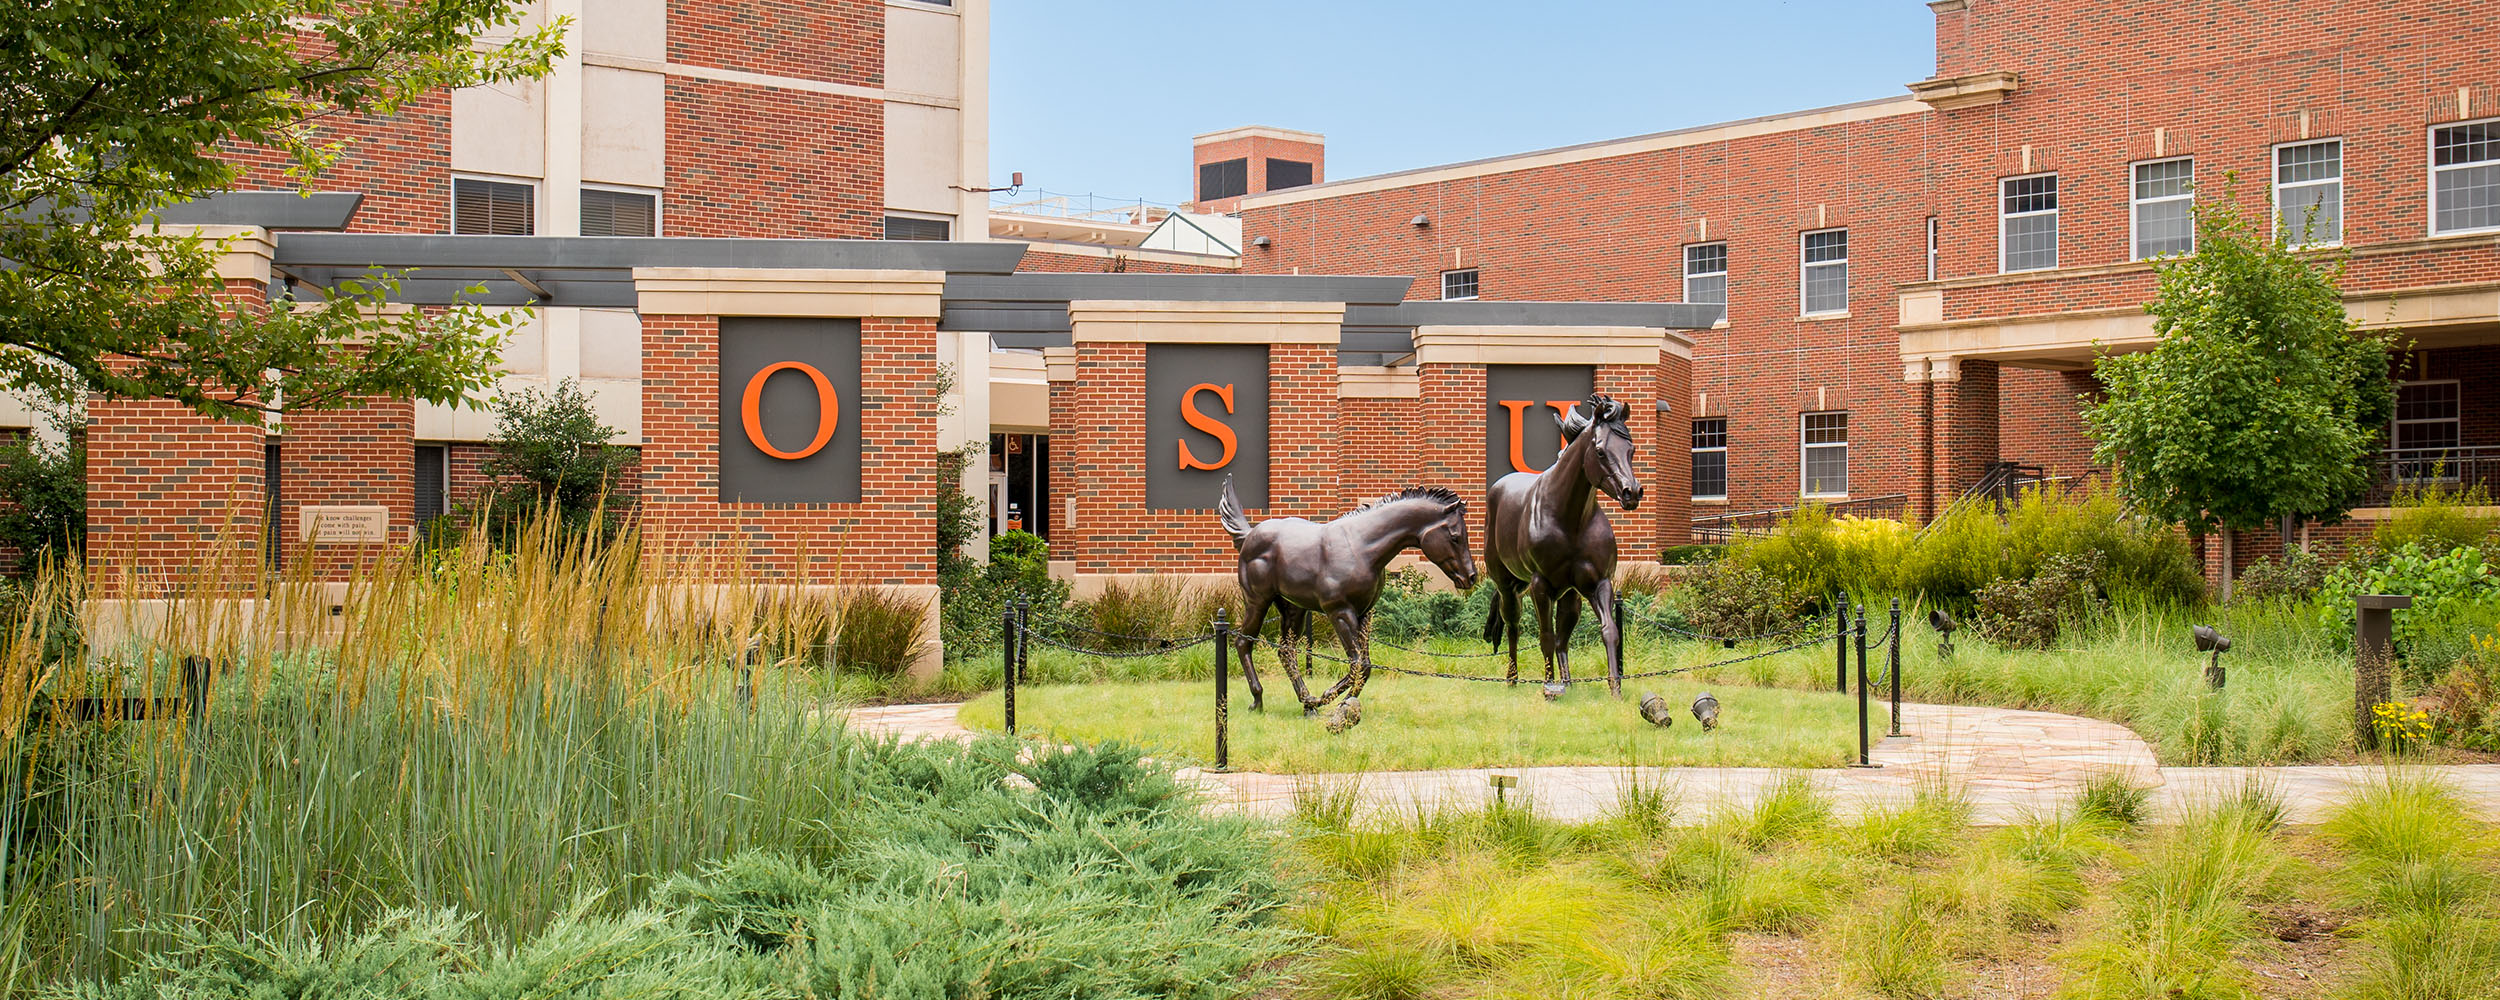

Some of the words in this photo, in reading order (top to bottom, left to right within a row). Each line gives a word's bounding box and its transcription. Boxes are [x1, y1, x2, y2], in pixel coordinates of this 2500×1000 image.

[741, 361, 839, 460] O
[1178, 383, 1238, 471] S
[1499, 400, 1581, 475] U
[337, 521, 350, 529] with
